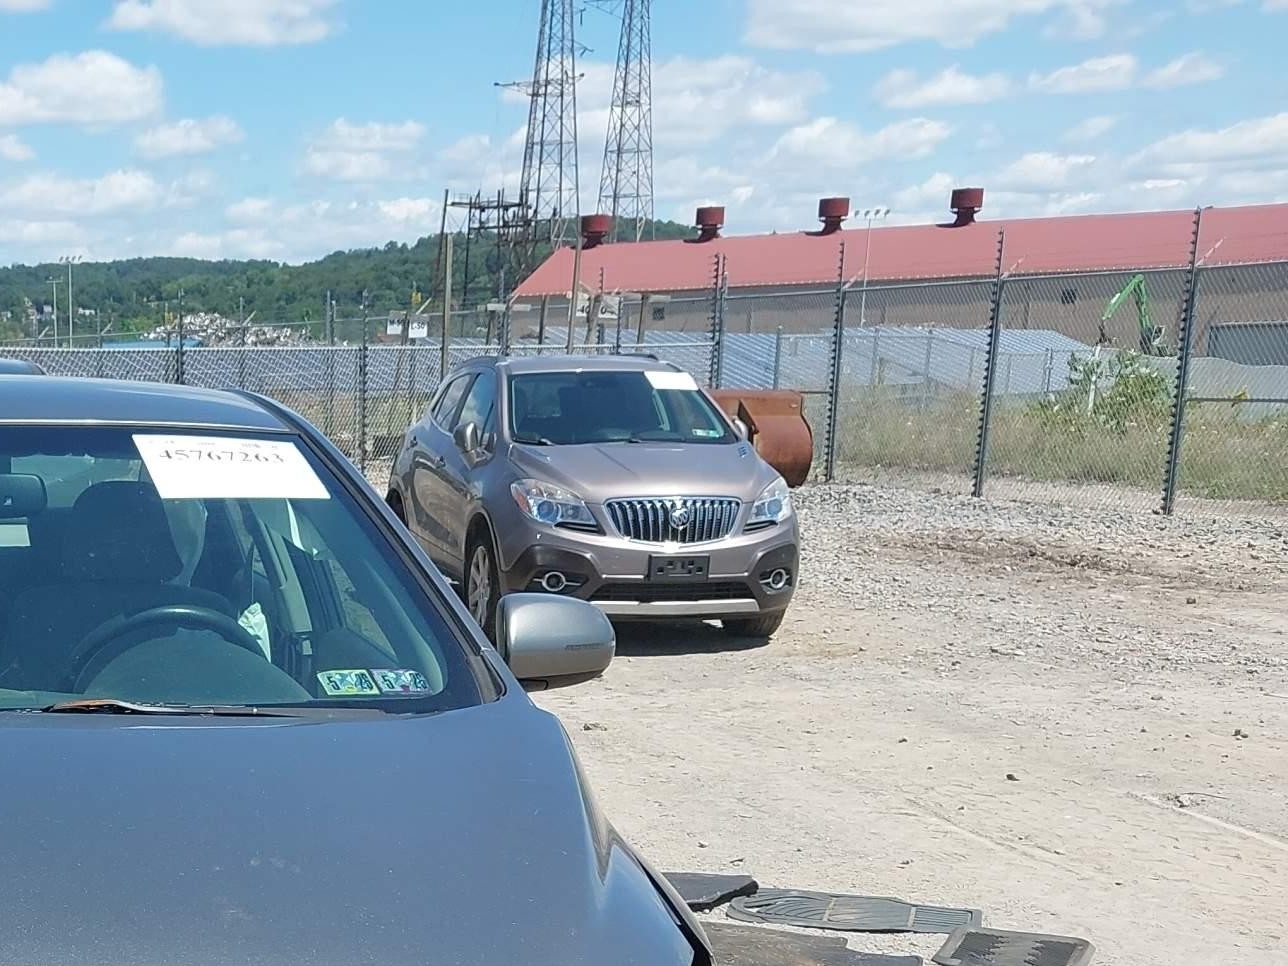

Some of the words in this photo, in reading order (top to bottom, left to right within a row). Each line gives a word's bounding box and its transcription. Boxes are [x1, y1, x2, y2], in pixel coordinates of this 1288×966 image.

[159, 449, 284, 463] 45767263
[326, 675, 341, 691] 5
[381, 674, 395, 690] 5
